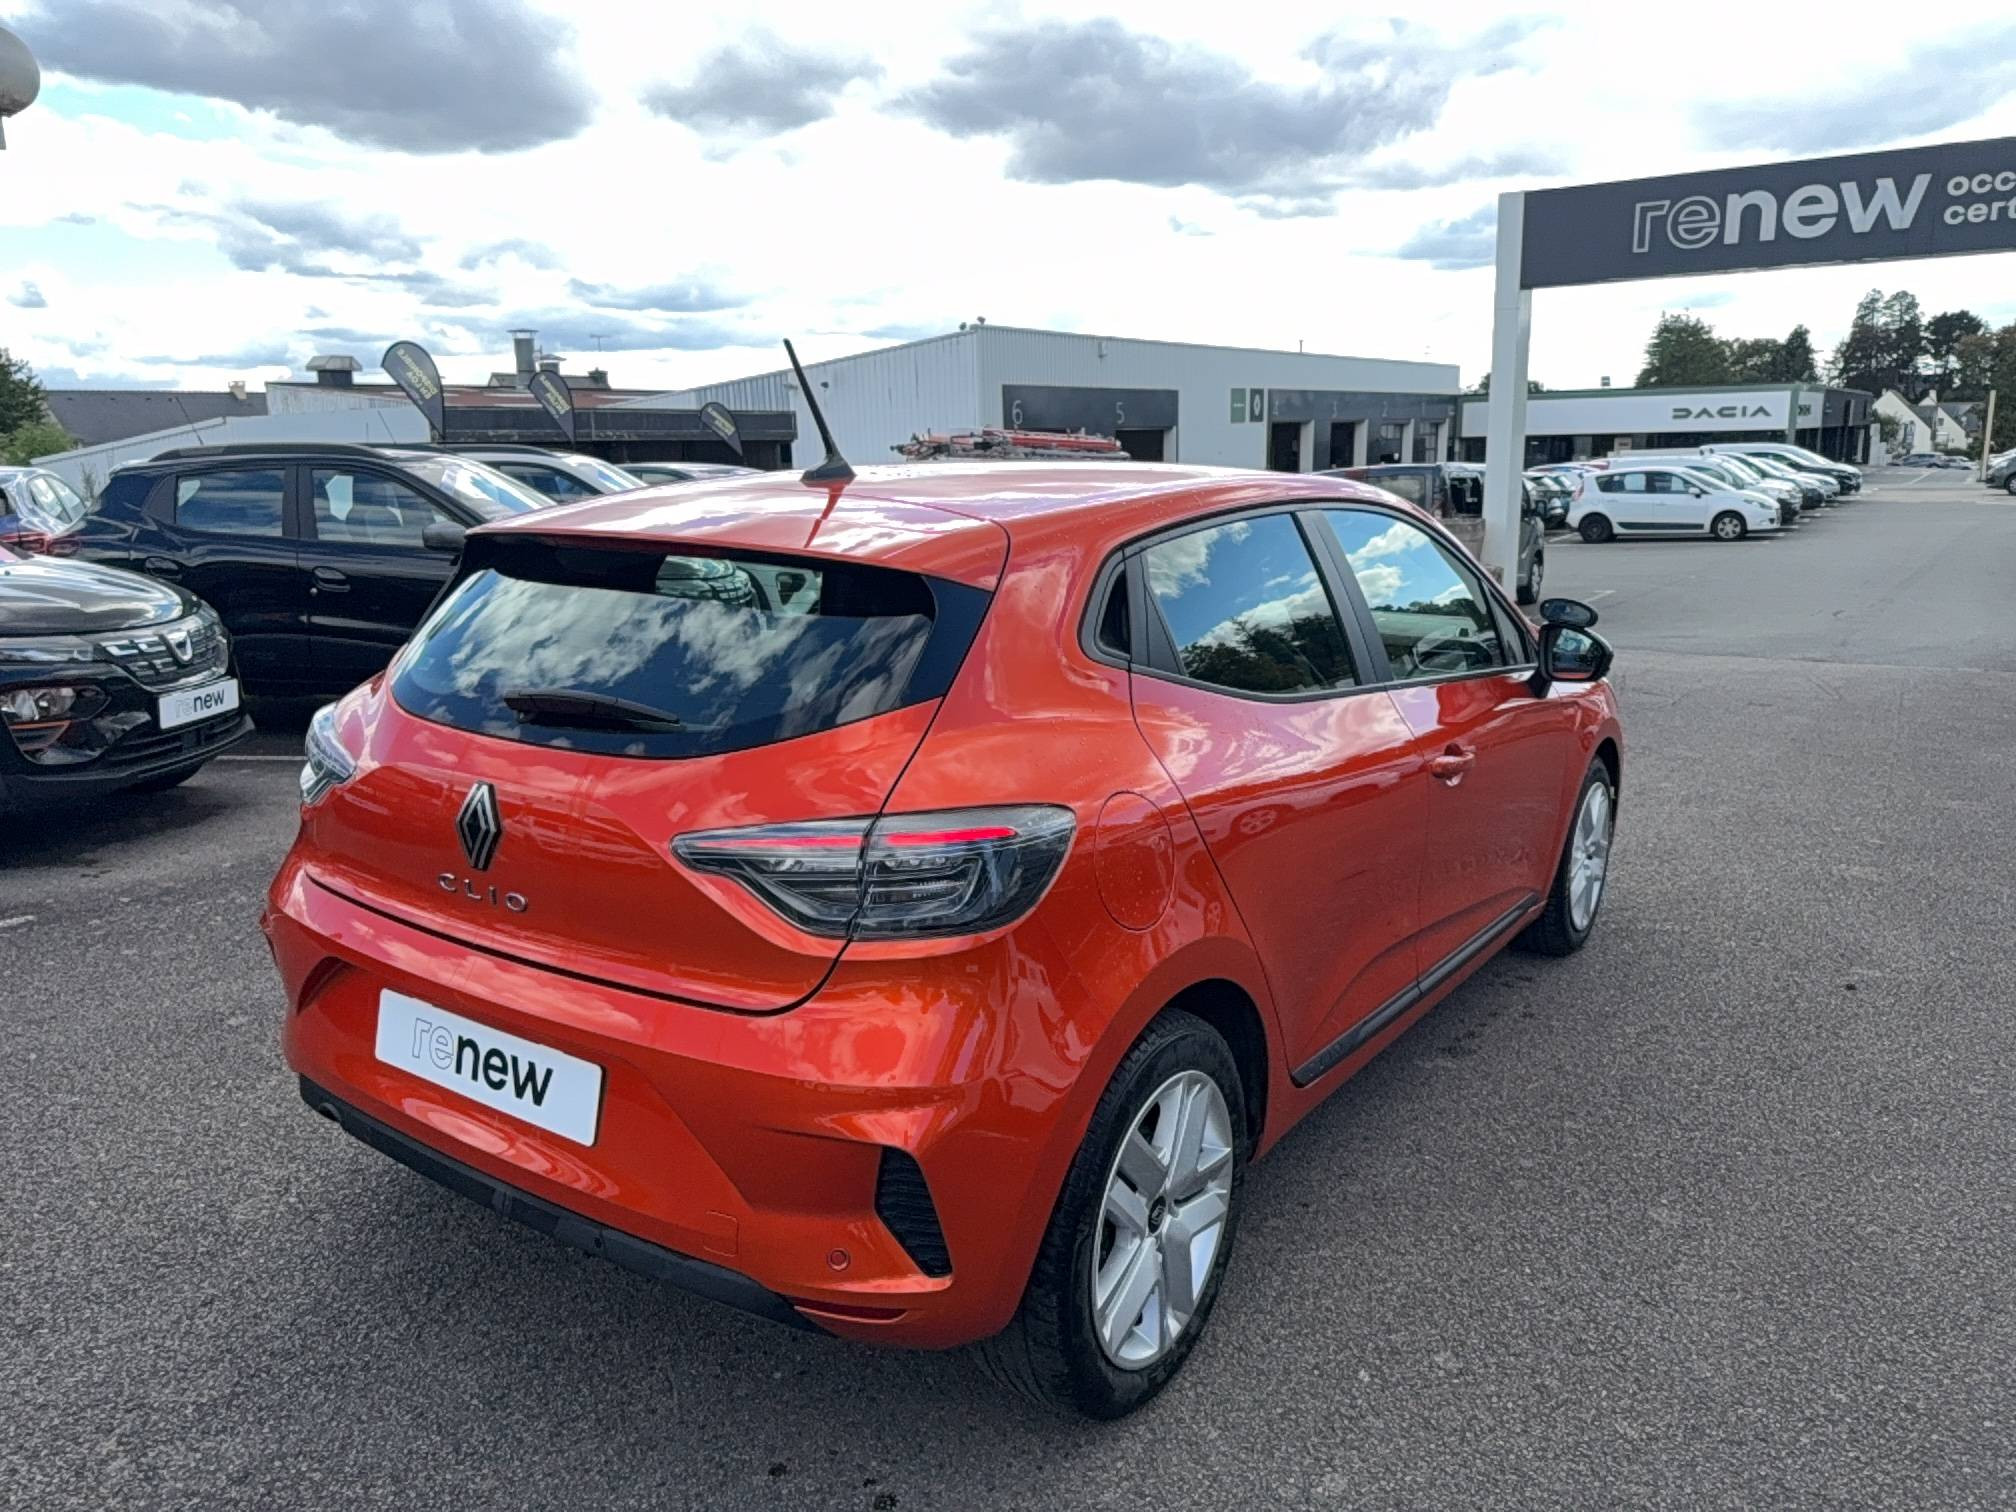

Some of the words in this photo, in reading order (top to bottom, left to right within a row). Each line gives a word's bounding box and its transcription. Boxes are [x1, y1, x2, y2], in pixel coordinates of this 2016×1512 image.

[1947, 171, 2016, 196] occ
[1632, 173, 1933, 253] renew
[1011, 400, 1023, 425] 6
[1115, 402, 1125, 424] 5
[1672, 405, 1772, 419] DACIA
[175, 688, 225, 718] renew
[438, 873, 529, 912] CLIO
[411, 1017, 554, 1107] renew
